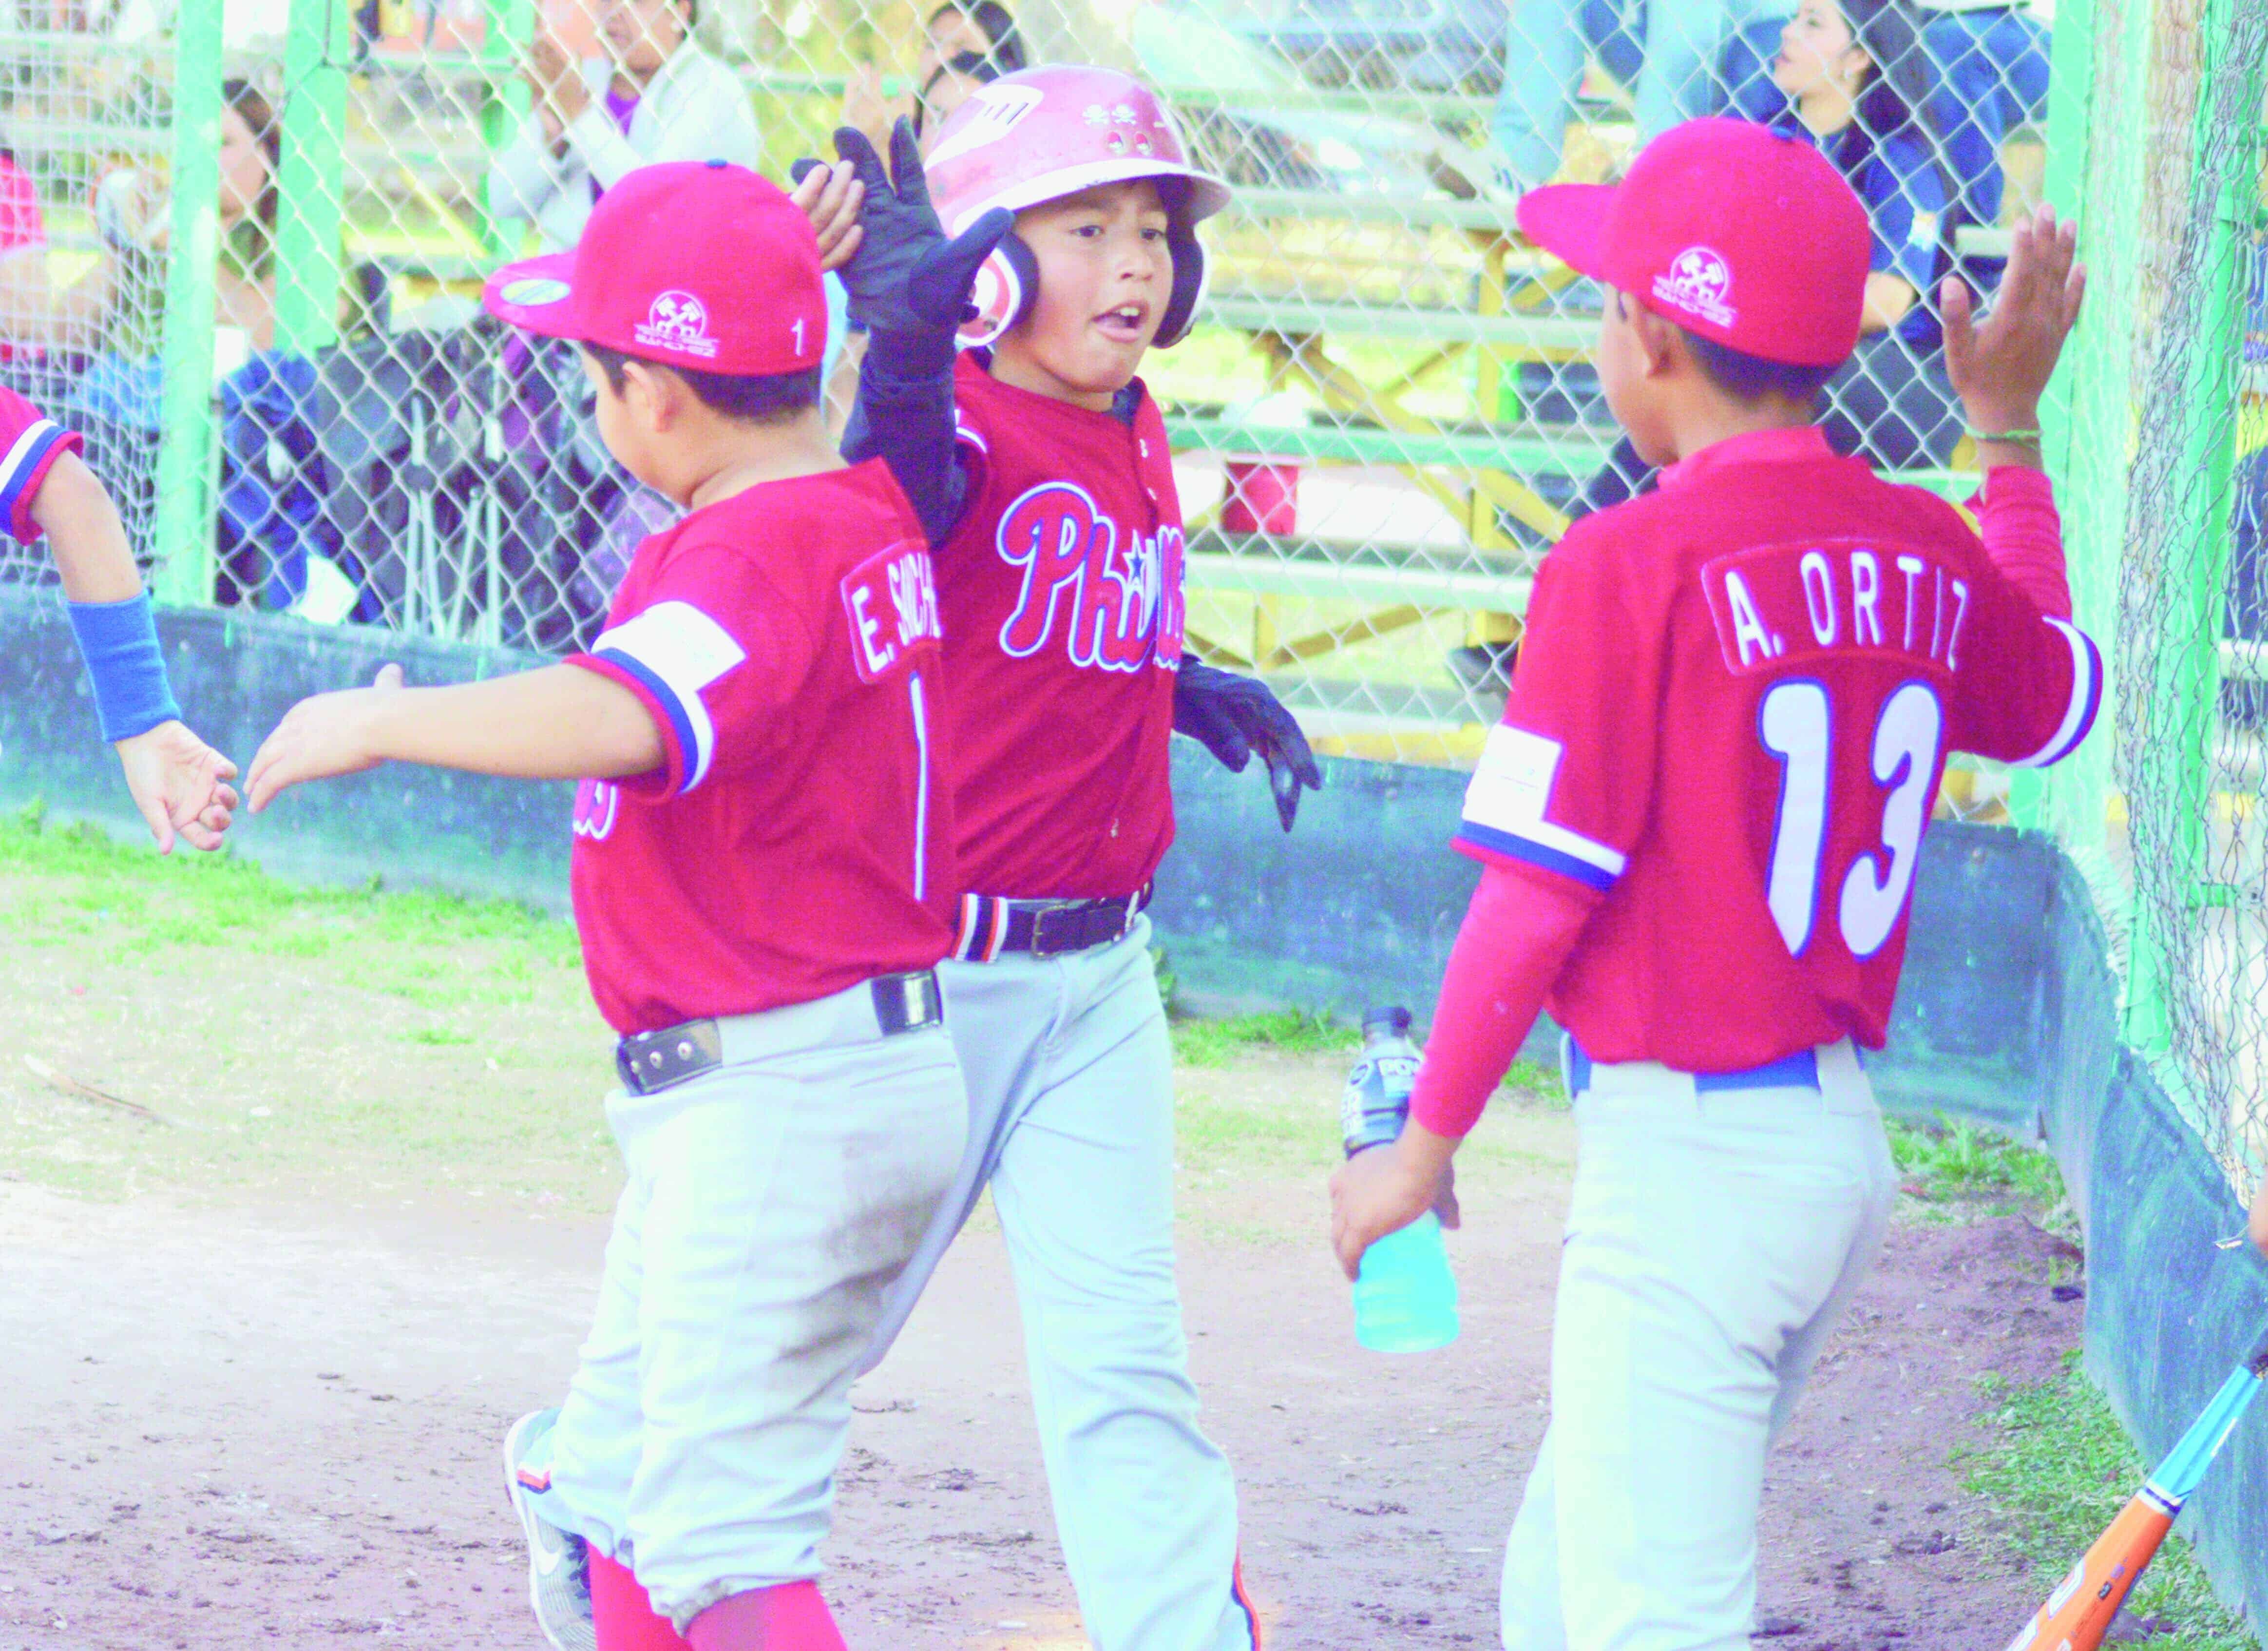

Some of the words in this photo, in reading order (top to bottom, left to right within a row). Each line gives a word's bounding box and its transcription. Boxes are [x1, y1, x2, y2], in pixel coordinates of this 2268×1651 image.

[790, 318, 803, 357] 1
[852, 586, 895, 673] E.
[1725, 570, 1783, 666] A.
[1800, 551, 1967, 672] ORTIZ
[1756, 676, 1945, 960] 13
